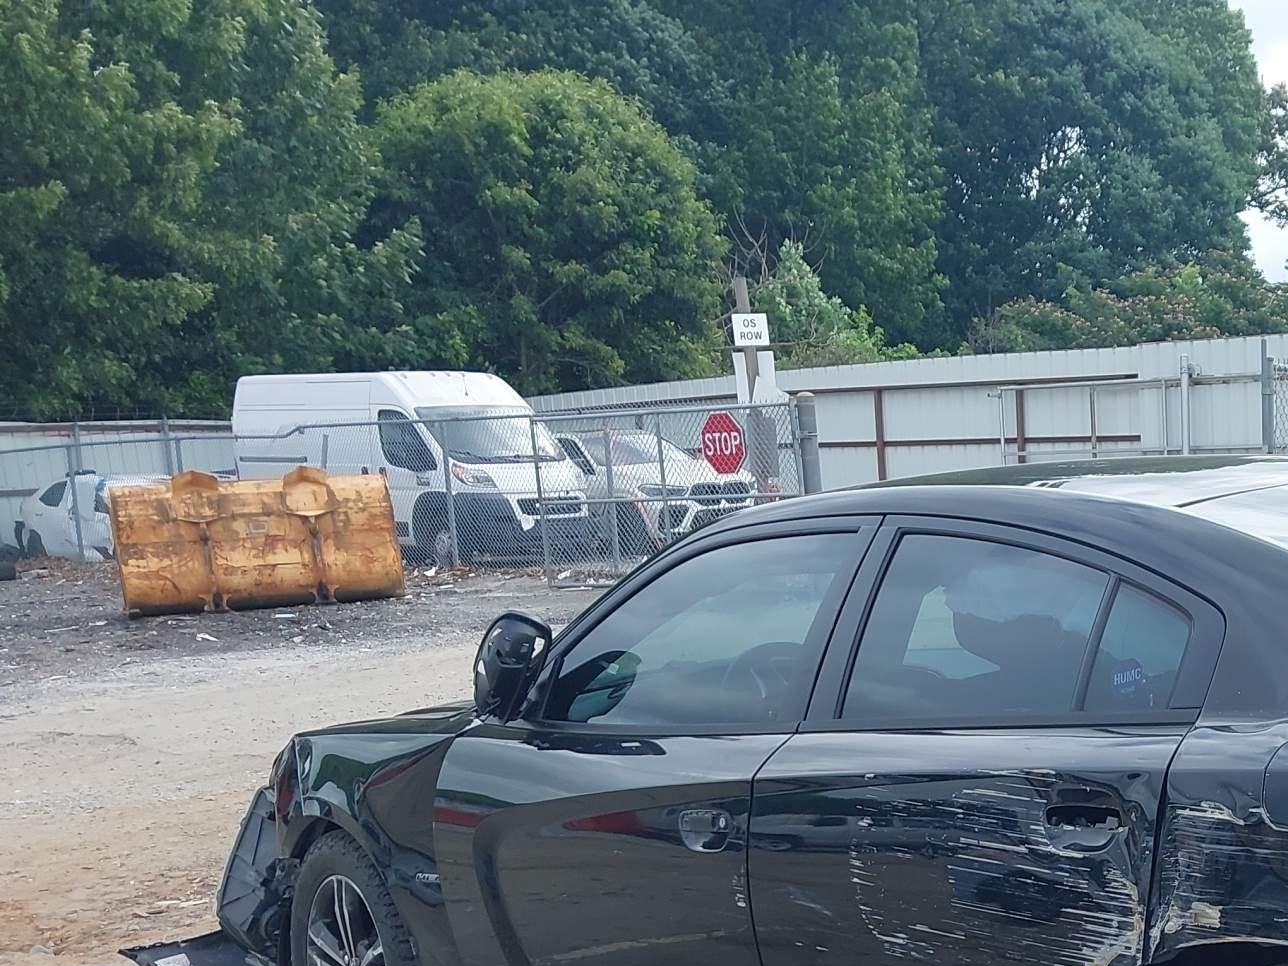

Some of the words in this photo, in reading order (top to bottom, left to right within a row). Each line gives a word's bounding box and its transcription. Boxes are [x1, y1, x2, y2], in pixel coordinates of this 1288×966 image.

[742, 318, 757, 328] OS
[740, 331, 763, 341] ROW
[704, 431, 741, 456] STOP
[1114, 667, 1141, 686] HUMC
